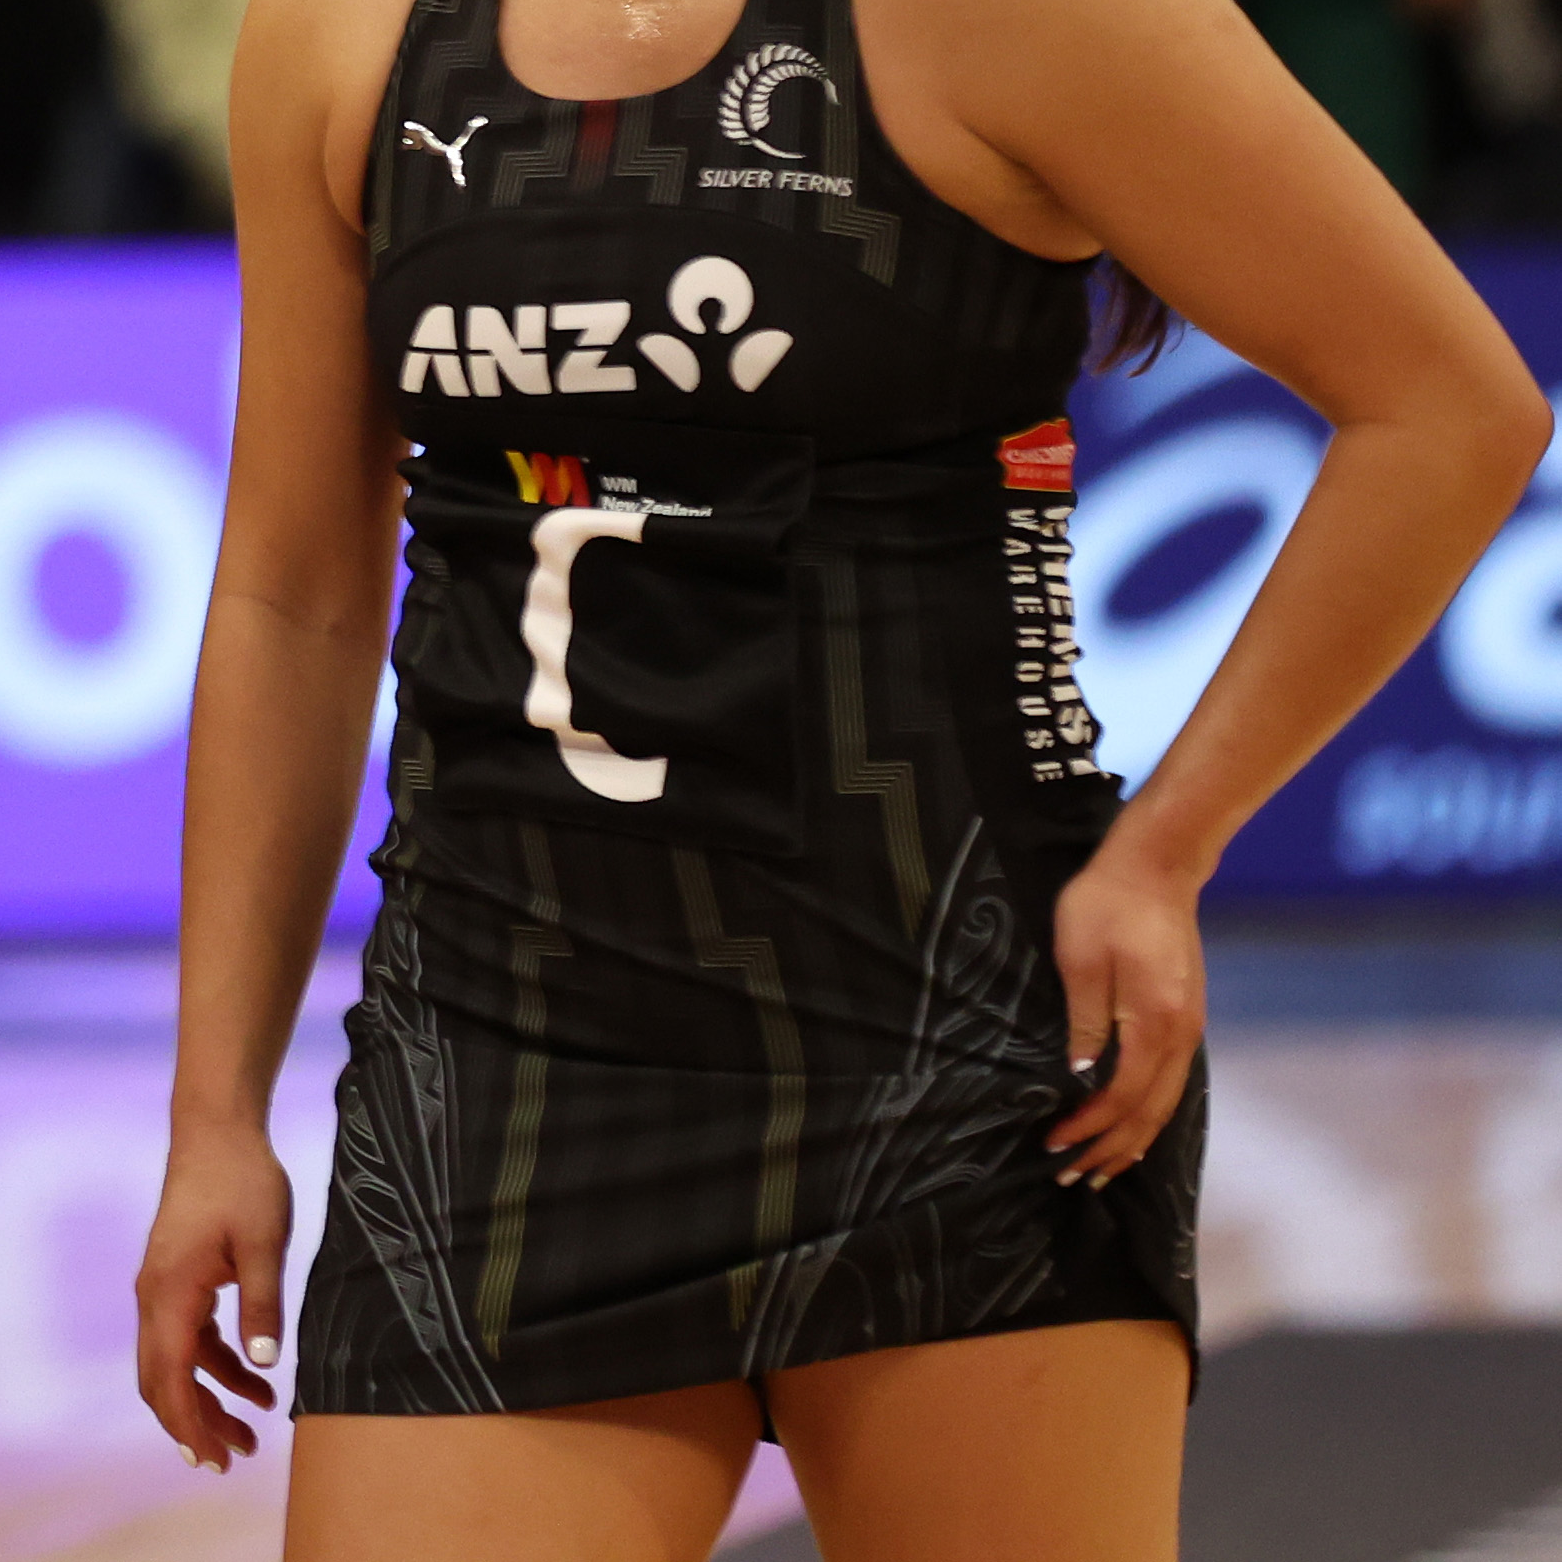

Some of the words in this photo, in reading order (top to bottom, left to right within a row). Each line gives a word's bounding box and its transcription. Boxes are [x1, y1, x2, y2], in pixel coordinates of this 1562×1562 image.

[697, 167, 774, 190] SILVER
[778, 169, 855, 198] FERNS
[399, 299, 637, 398] ANZ
[600, 475, 638, 494] WM
